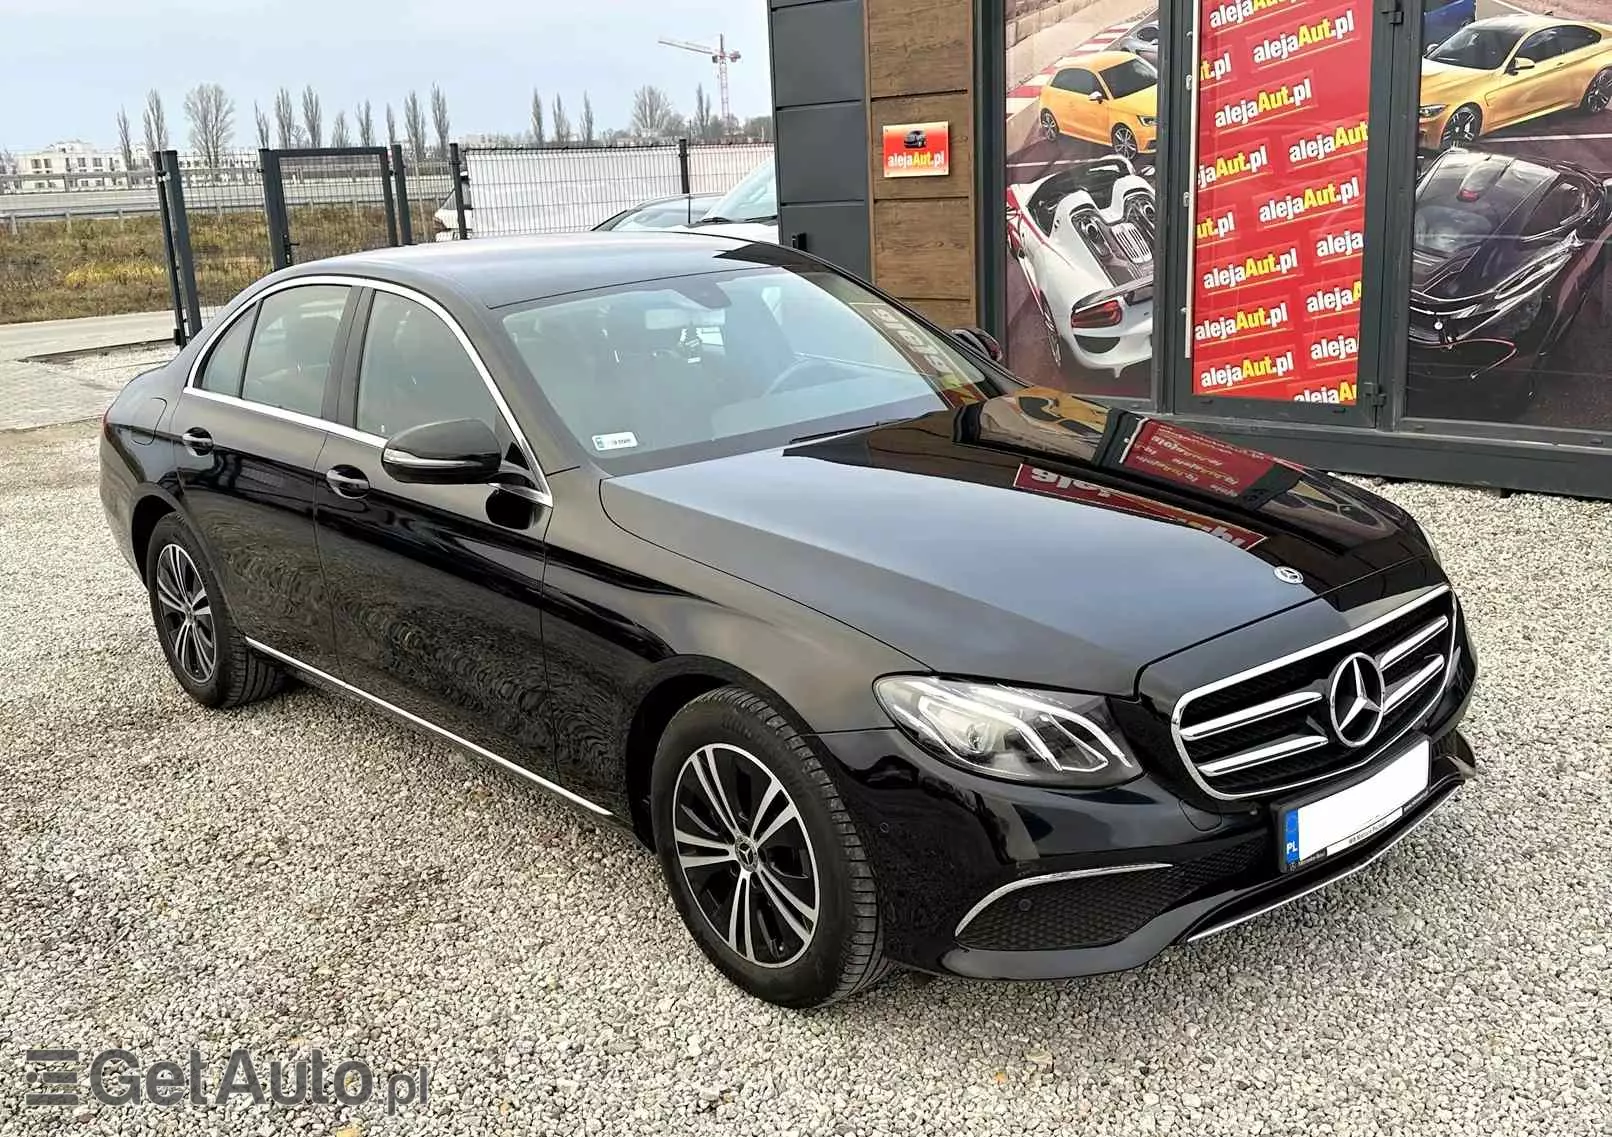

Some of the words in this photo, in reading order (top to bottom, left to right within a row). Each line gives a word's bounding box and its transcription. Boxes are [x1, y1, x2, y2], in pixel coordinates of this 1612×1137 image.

[1253, 10, 1355, 63] alejaAut.pl
[1214, 78, 1312, 127] alejaAut.pl
[887, 150, 945, 168] alejaAut.pl
[1198, 145, 1268, 189] jaAut.pl
[1259, 177, 1360, 222] alejaAut.pl
[1316, 231, 1364, 257] aleja
[1203, 248, 1298, 289] alejaAut.pl
[1195, 303, 1288, 340] alejaAut.pl
[1310, 335, 1358, 360] aleja
[1200, 352, 1294, 387] alejaAut.pl
[1286, 840, 1298, 855] PL
